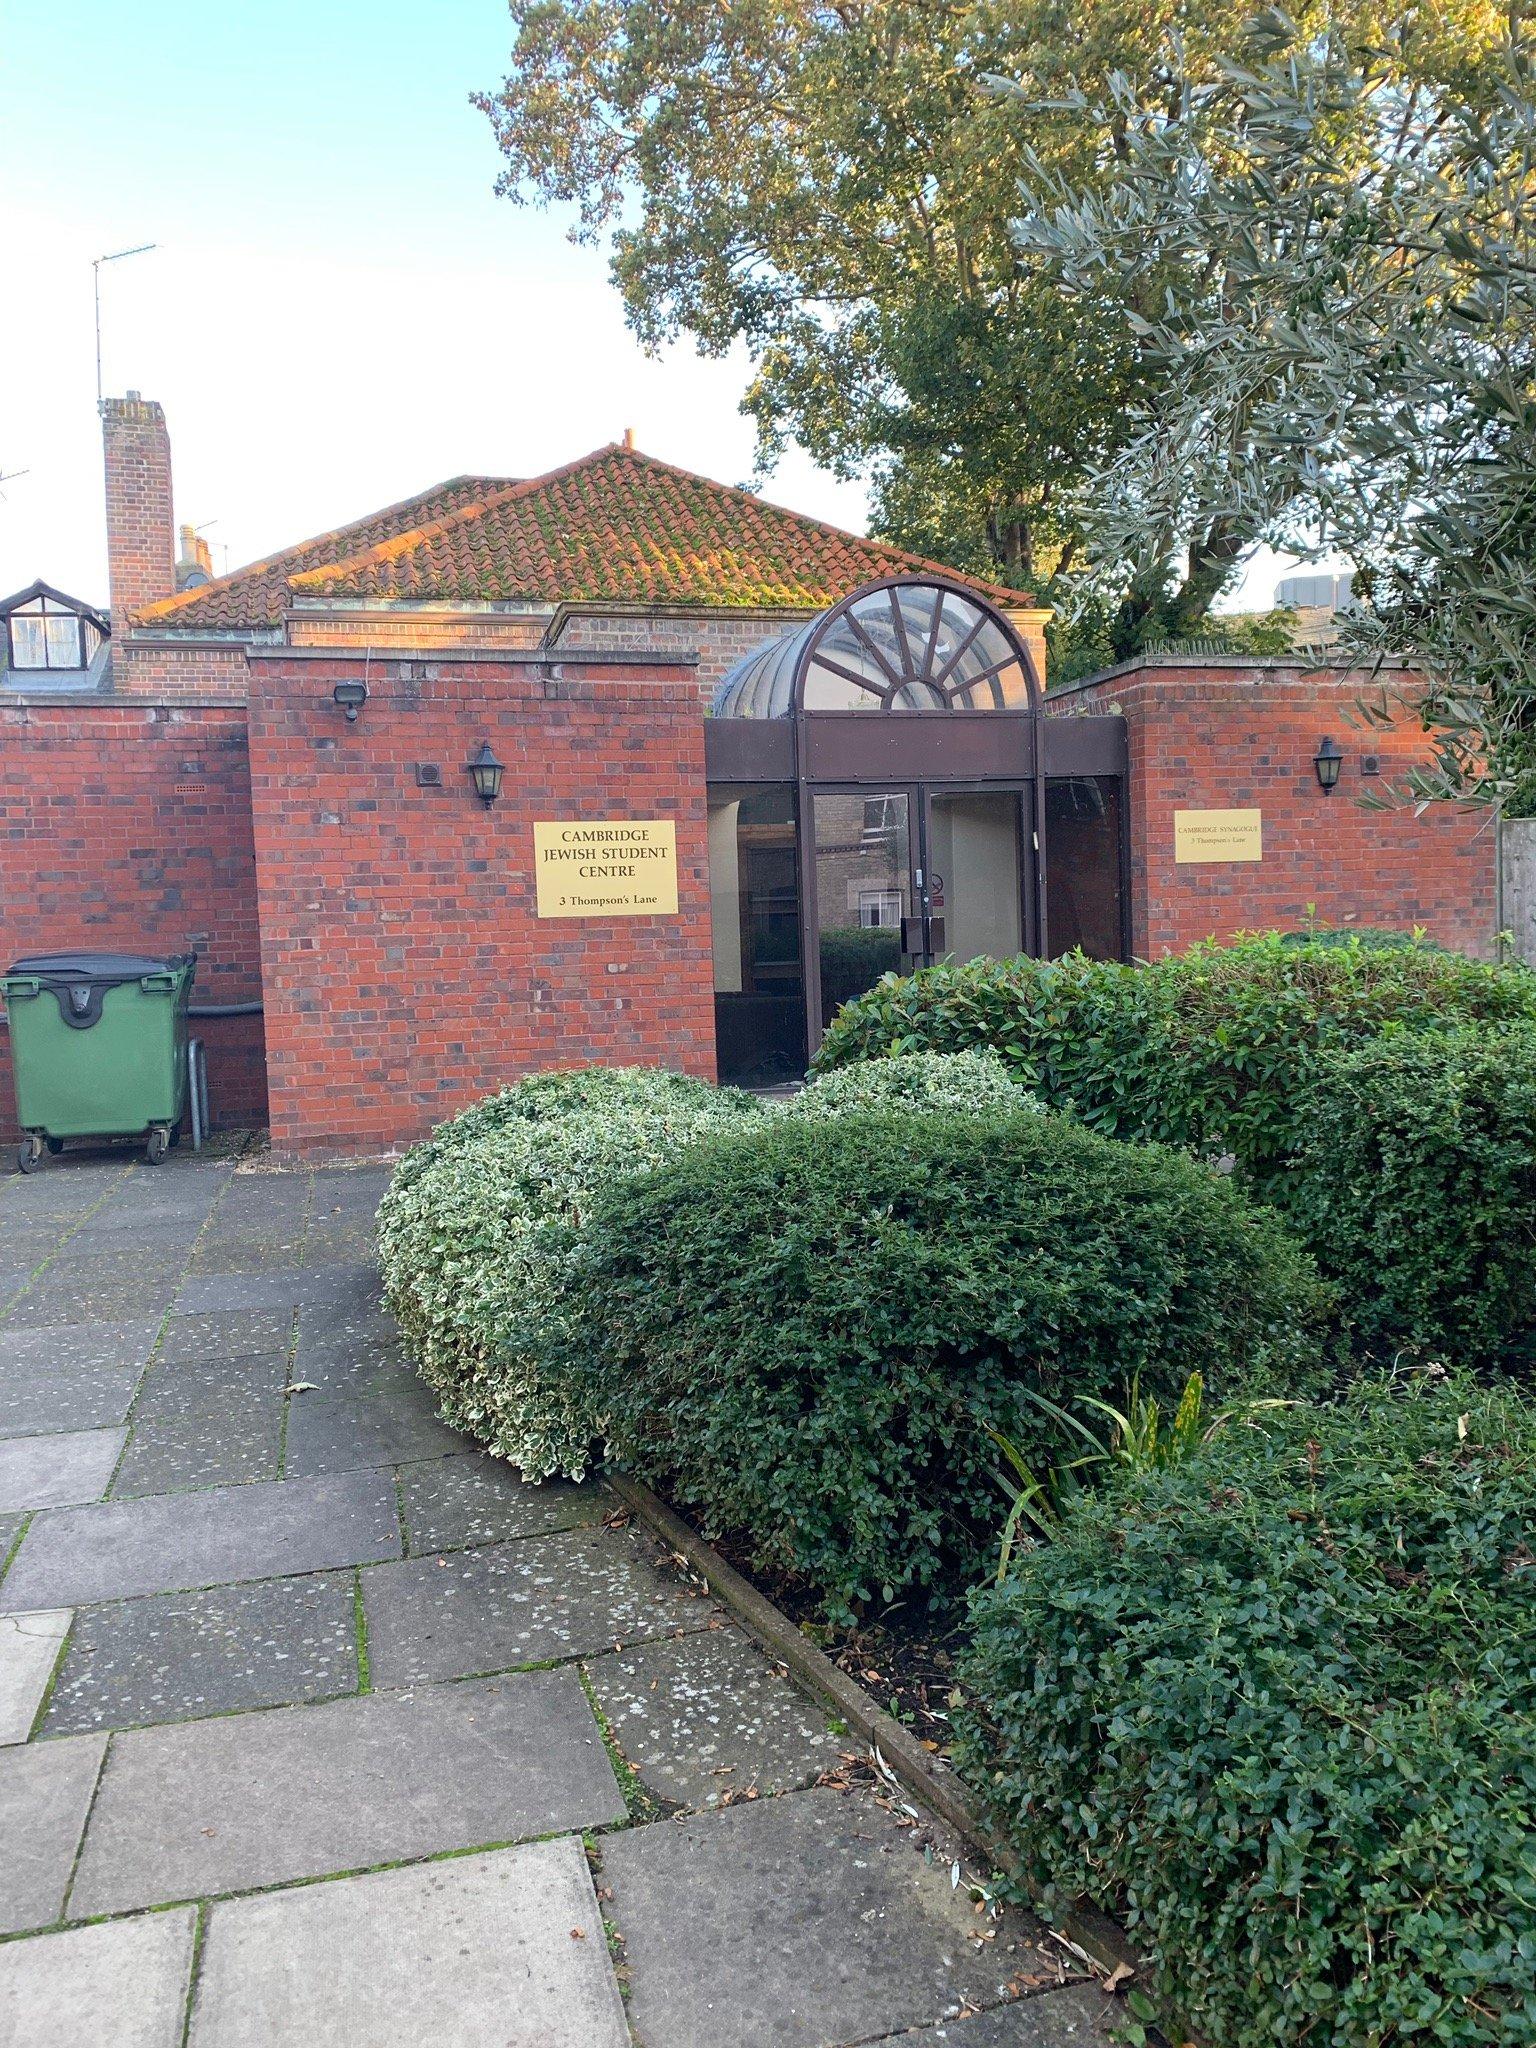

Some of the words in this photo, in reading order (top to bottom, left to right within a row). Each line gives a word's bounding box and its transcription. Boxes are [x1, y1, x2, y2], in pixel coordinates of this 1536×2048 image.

[562, 830, 649, 842] CAMBRIDGE
[1178, 826, 1217, 834] CAMBRIDGE
[543, 849, 596, 862] JEWISH
[602, 847, 667, 860] STUDENT
[579, 865, 636, 878] CENTRE
[559, 896, 566, 906] 3
[570, 895, 629, 907] Thompson's
[633, 895, 658, 904] Lane
